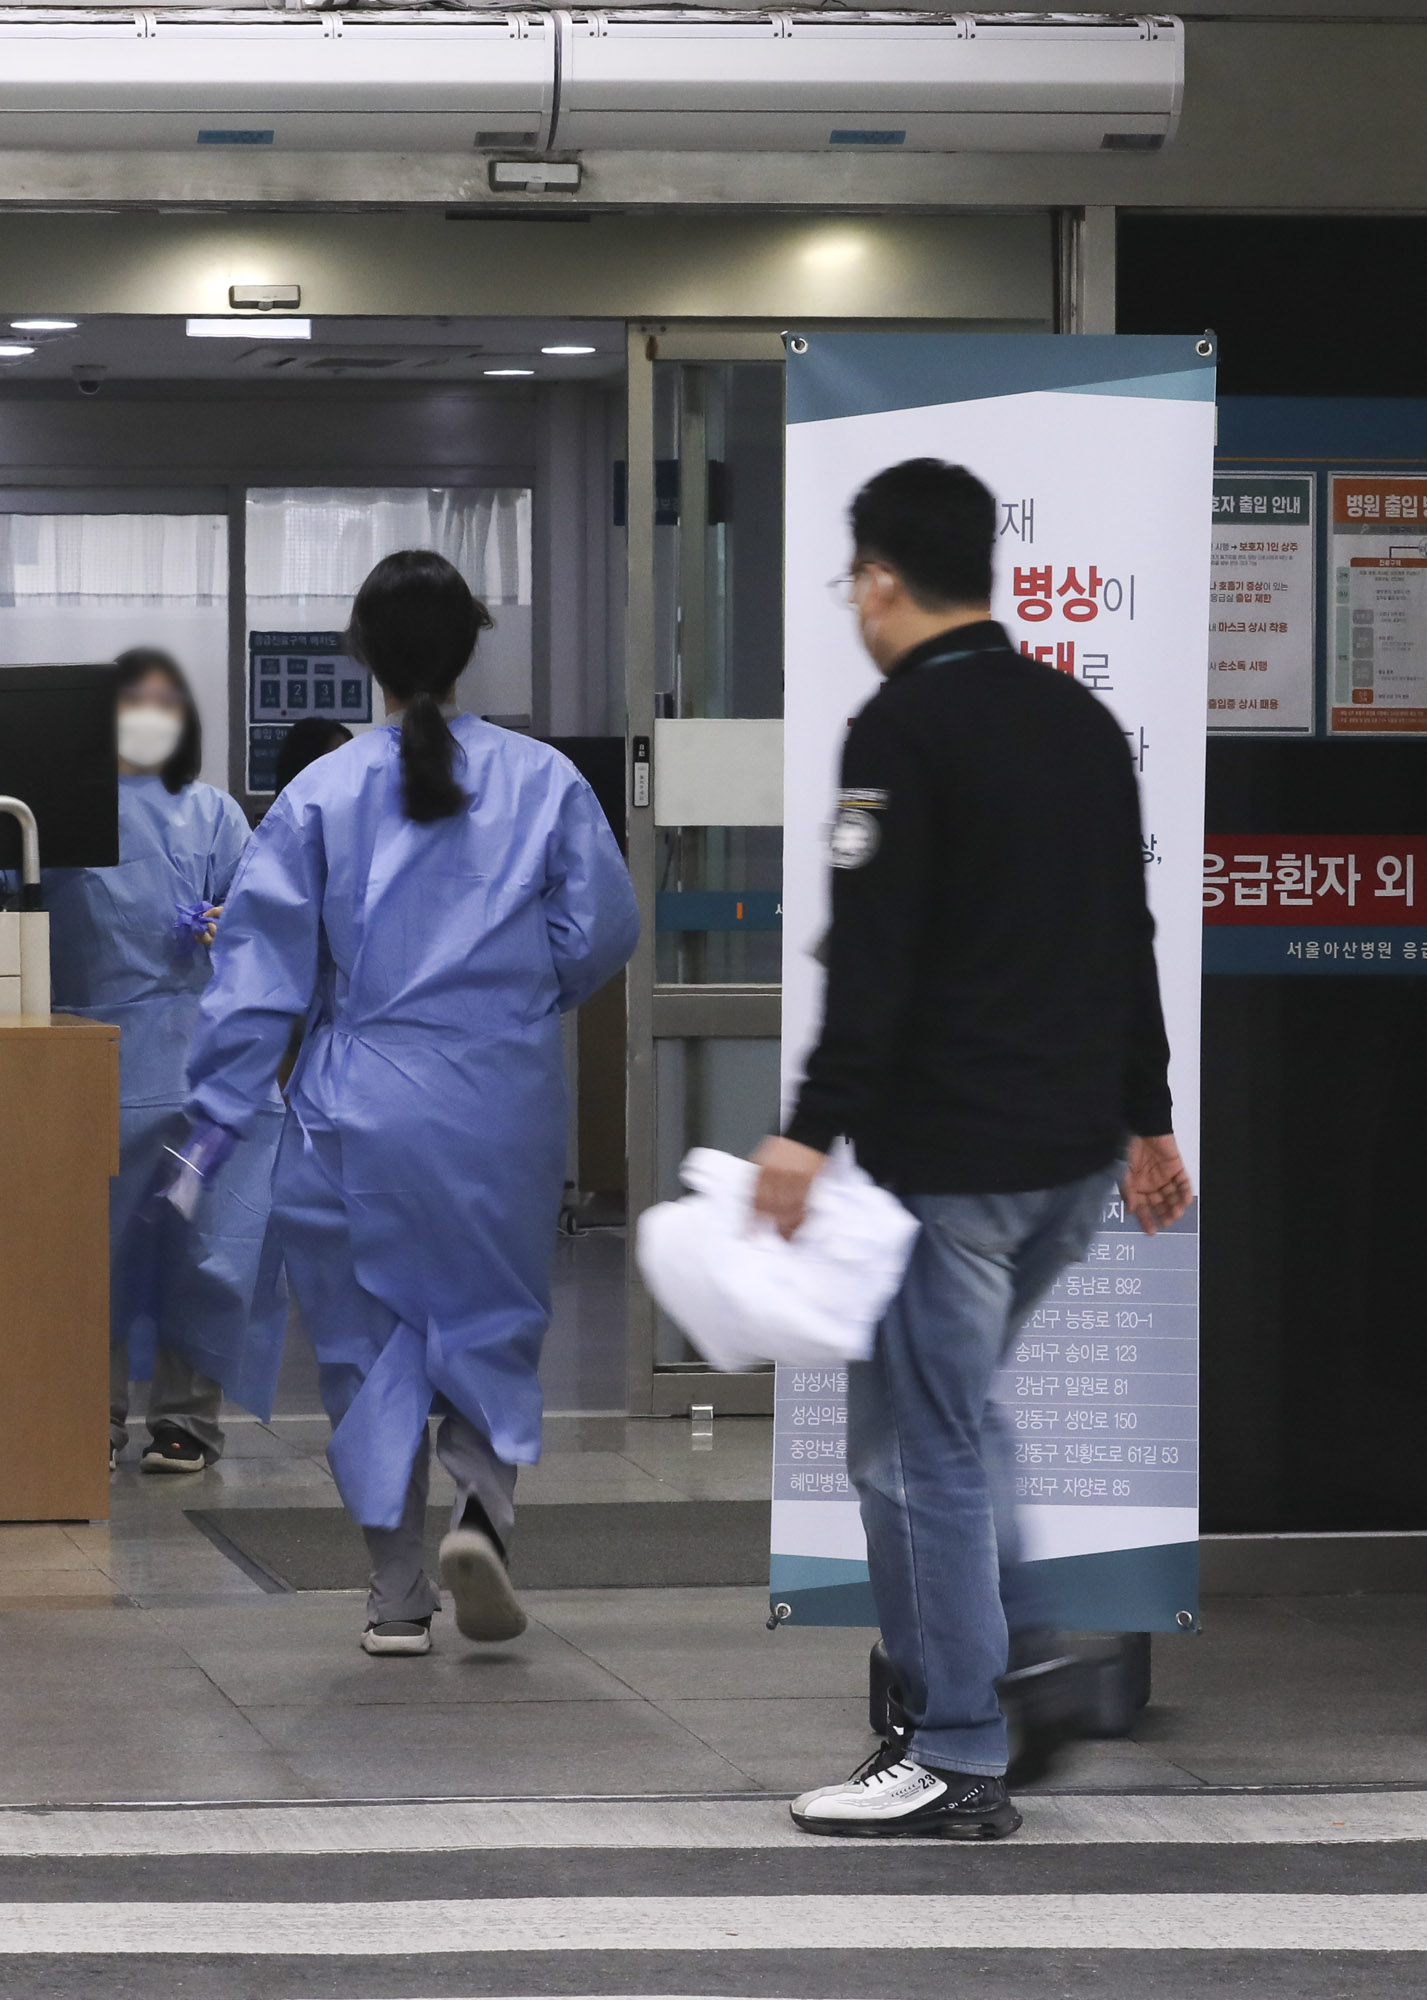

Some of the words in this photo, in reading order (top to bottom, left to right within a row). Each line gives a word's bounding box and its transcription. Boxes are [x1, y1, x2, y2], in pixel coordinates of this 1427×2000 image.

[1239, 495, 1267, 514] 출입
[1272, 496, 1301, 514] 안내
[1346, 494, 1380, 517] 병원
[1384, 494, 1418, 518] 출입
[993, 498, 1034, 544] 재
[1239, 542, 1265, 552] 보호자
[1267, 542, 1279, 552] 1인
[1281, 542, 1298, 552] 상주
[1013, 565, 1135, 622] 병상이
[1219, 581, 1244, 591] 호흡기
[1246, 582, 1271, 591] 증상이
[1273, 582, 1288, 592] 있는
[1218, 622, 1246, 632] 마스크
[1248, 623, 1267, 632] 상시
[1269, 622, 1288, 633] 착용
[1218, 661, 1246, 671] 손소독
[1249, 661, 1268, 671] 시행
[294, 684, 302, 695] 2
[321, 684, 329, 695] 3
[1238, 699, 1257, 710] 상시
[1260, 699, 1279, 710] 패용
[1202, 853, 1361, 906] 응급환자
[1374, 855, 1414, 906] 외
[1287, 942, 1391, 959] 서울아산병원
[1116, 1244, 1135, 1260] 211
[1066, 1276, 1111, 1296] 동남로
[1115, 1278, 1142, 1295] 892
[1065, 1309, 1111, 1330] 능동로
[1115, 1312, 1153, 1329] 120-1
[1015, 1342, 1060, 1362] 송파구
[1065, 1343, 1110, 1363] 송이로
[1115, 1345, 1138, 1362] 123
[791, 1372, 849, 1393] 삼성서울
[1015, 1376, 1060, 1396] 강남구
[1065, 1376, 1110, 1396] 일원로
[1113, 1378, 1129, 1395] 81
[791, 1406, 849, 1426] 성심의료
[1014, 1410, 1060, 1430] 강동구
[1064, 1410, 1109, 1431] 성안로
[1114, 1412, 1137, 1430] 150
[790, 1440, 849, 1460] 중앙보훈
[1013, 1444, 1059, 1464] 강동구
[1064, 1444, 1124, 1465] 진황도로
[1127, 1446, 1157, 1465] 61길
[1161, 1447, 1179, 1464] 53
[789, 1472, 849, 1493] 혜민병원
[1015, 1477, 1058, 1497] 광진구
[1063, 1477, 1108, 1498] 자양로
[1112, 1479, 1130, 1497] 85
[918, 1774, 937, 1790] 23
